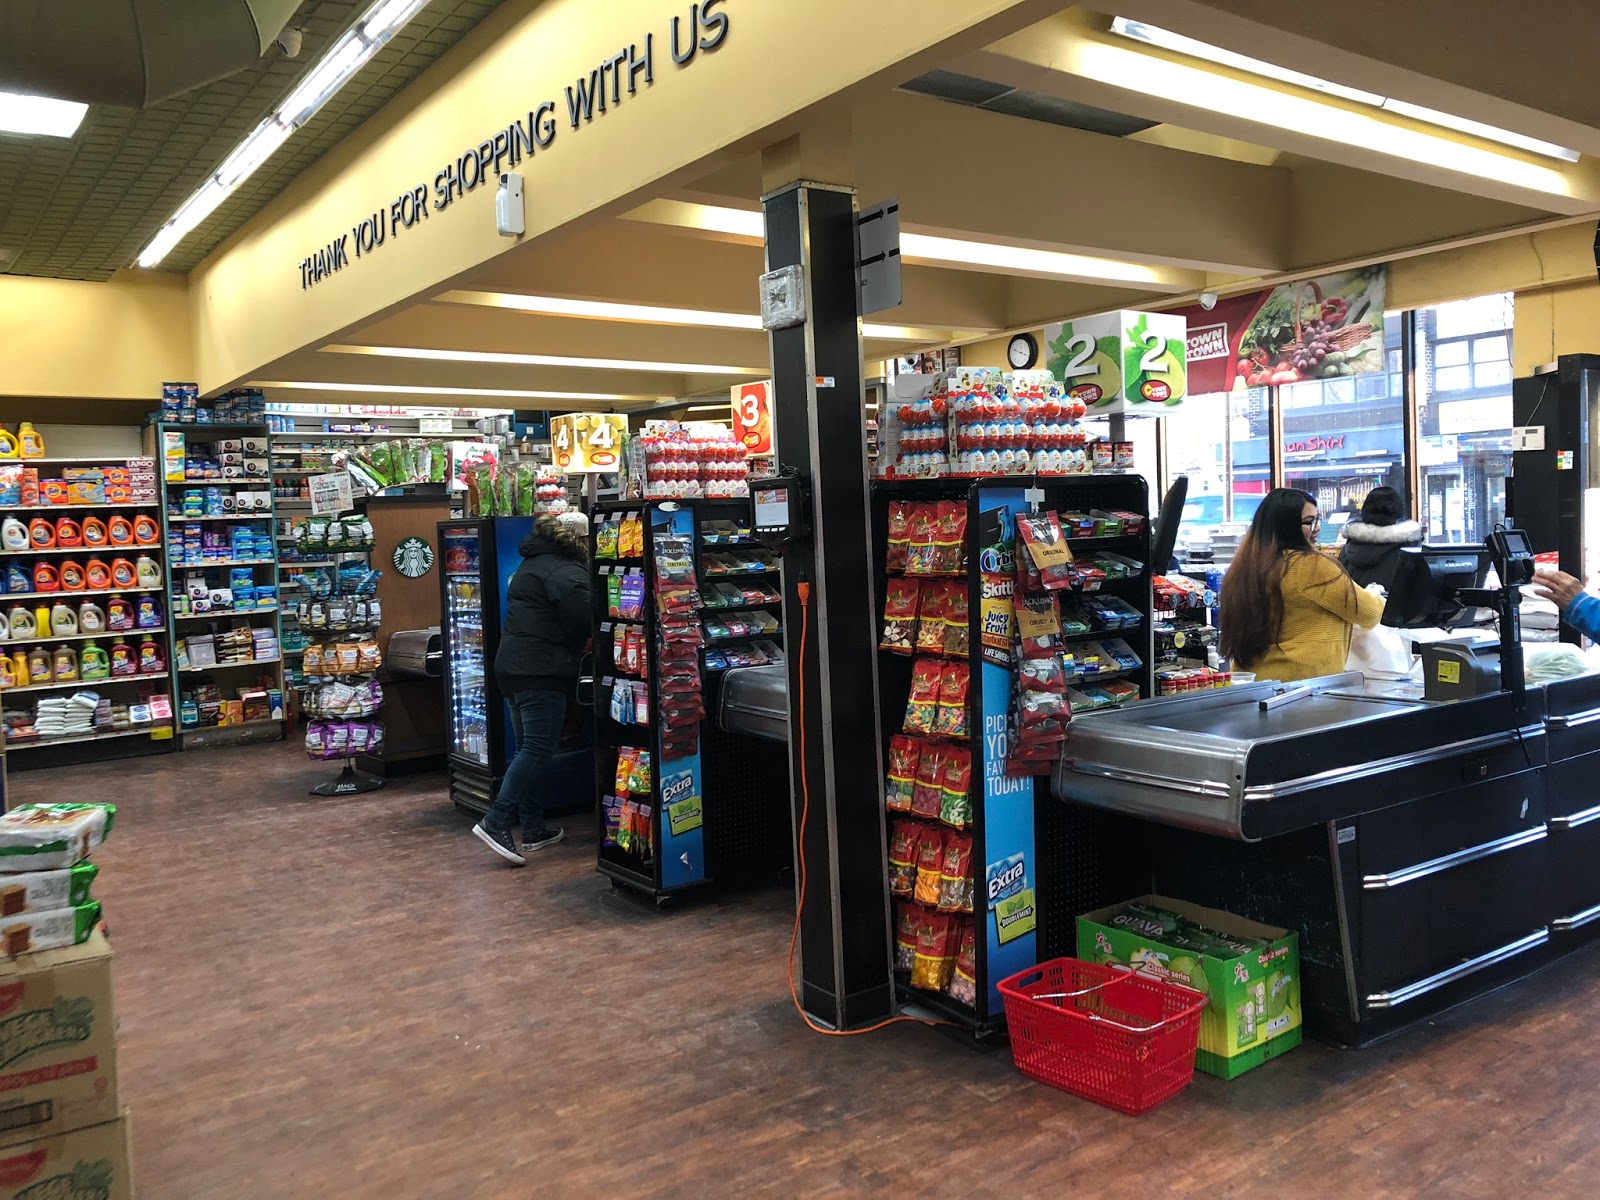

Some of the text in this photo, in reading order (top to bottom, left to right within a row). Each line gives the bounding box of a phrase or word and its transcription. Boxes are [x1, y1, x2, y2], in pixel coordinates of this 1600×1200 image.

[298, 0, 729, 290] THANK YOU FOR SHOPPING WITH US
[1064, 332, 1099, 379] 2
[1140, 329, 1169, 373] 2
[741, 394, 759, 427] 3
[557, 424, 569, 450] 4
[588, 423, 614, 449] 4
[980, 548, 1015, 573] Orbi
[983, 581, 1014, 599] Skittl
[985, 610, 1009, 623] Juicy
[1030, 618, 1056, 626] ORIGAL
[986, 714, 1007, 734] PIC
[987, 733, 1007, 760] YO
[986, 760, 1006, 777] FAV
[663, 776, 692, 803] Extra
[987, 775, 1030, 797] TODAY!
[988, 862, 1024, 899] Extra
[1002, 906, 1032, 928] DOUBLEMINT
[1113, 915, 1165, 936] GUAVA
[1147, 962, 1192, 983] Classic series
